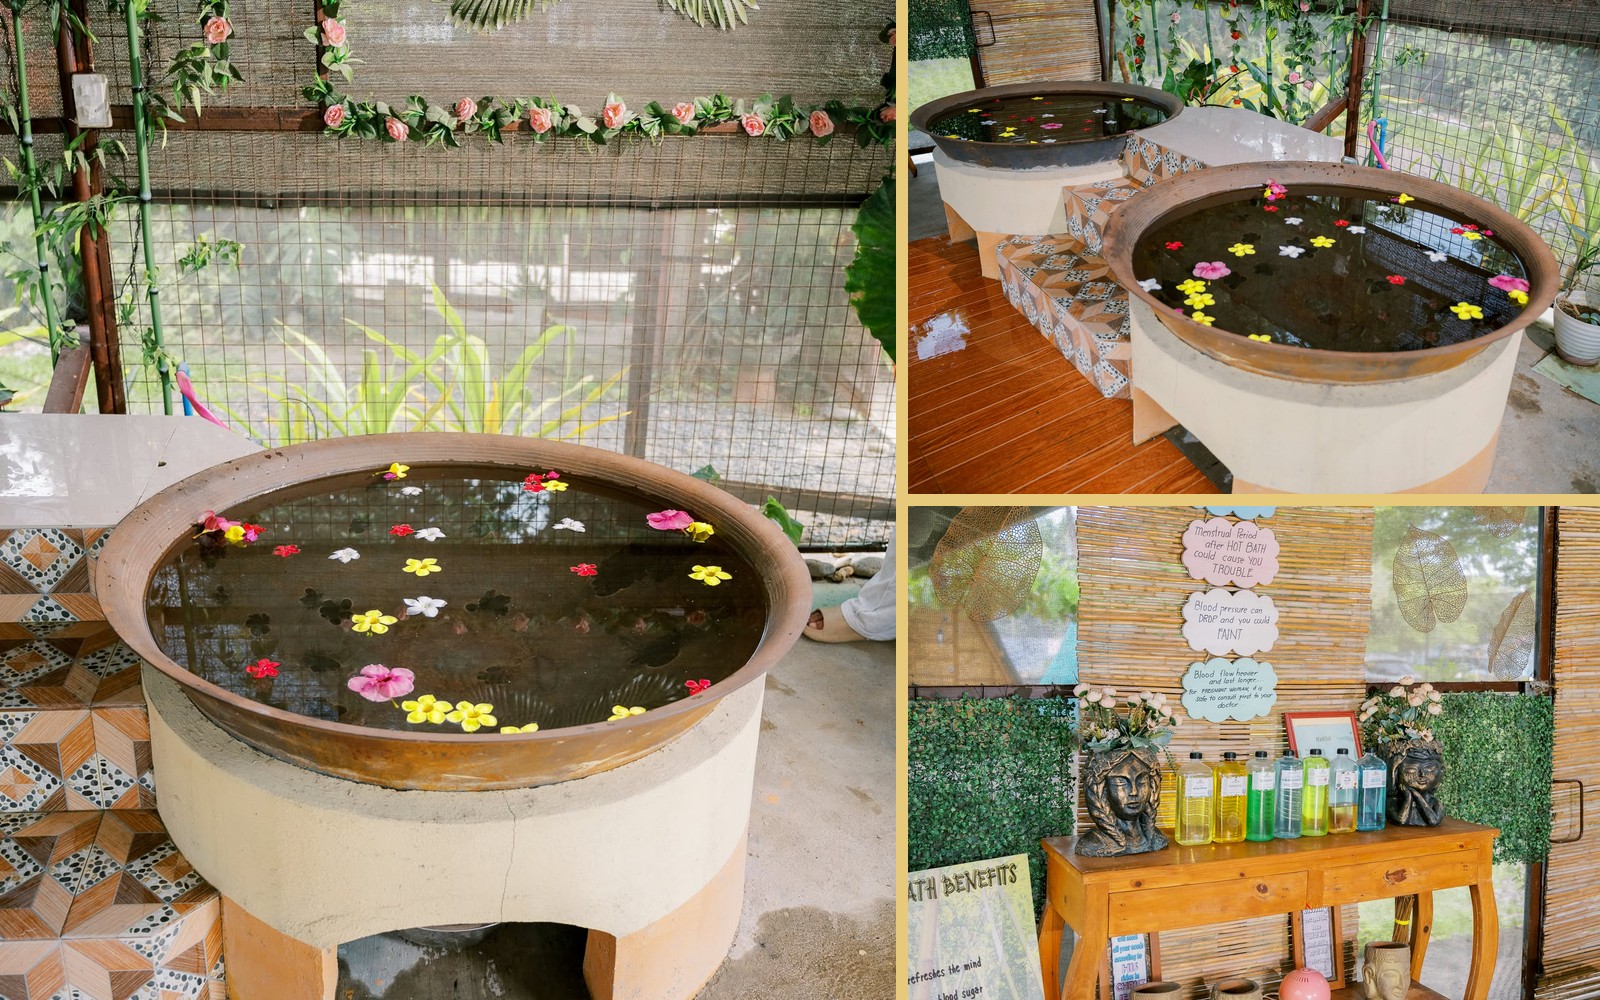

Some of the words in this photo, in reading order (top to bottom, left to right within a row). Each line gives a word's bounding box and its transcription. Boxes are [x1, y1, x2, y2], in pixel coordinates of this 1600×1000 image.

[1194, 526, 1232, 538] Menstrual
[1237, 528, 1257, 539] Period
[1205, 540, 1224, 550] after
[1227, 541, 1243, 552] HOT
[1246, 542, 1267, 554] BATH
[1194, 550, 1216, 560] could
[1222, 555, 1245, 564] cause
[1248, 556, 1263, 566] YOU
[1212, 563, 1254, 578] TROUBLE
[1194, 600, 1218, 612] Blood
[1220, 606, 1248, 615] pressure
[1198, 614, 1218, 623] DROP
[1220, 616, 1234, 624] and
[1254, 616, 1270, 624] could
[1194, 670, 1215, 679] Blood
[940, 862, 1017, 897] BENEFITS
[948, 964, 960, 975] the
[964, 956, 982, 970] mind
[962, 986, 983, 1000] sugar
